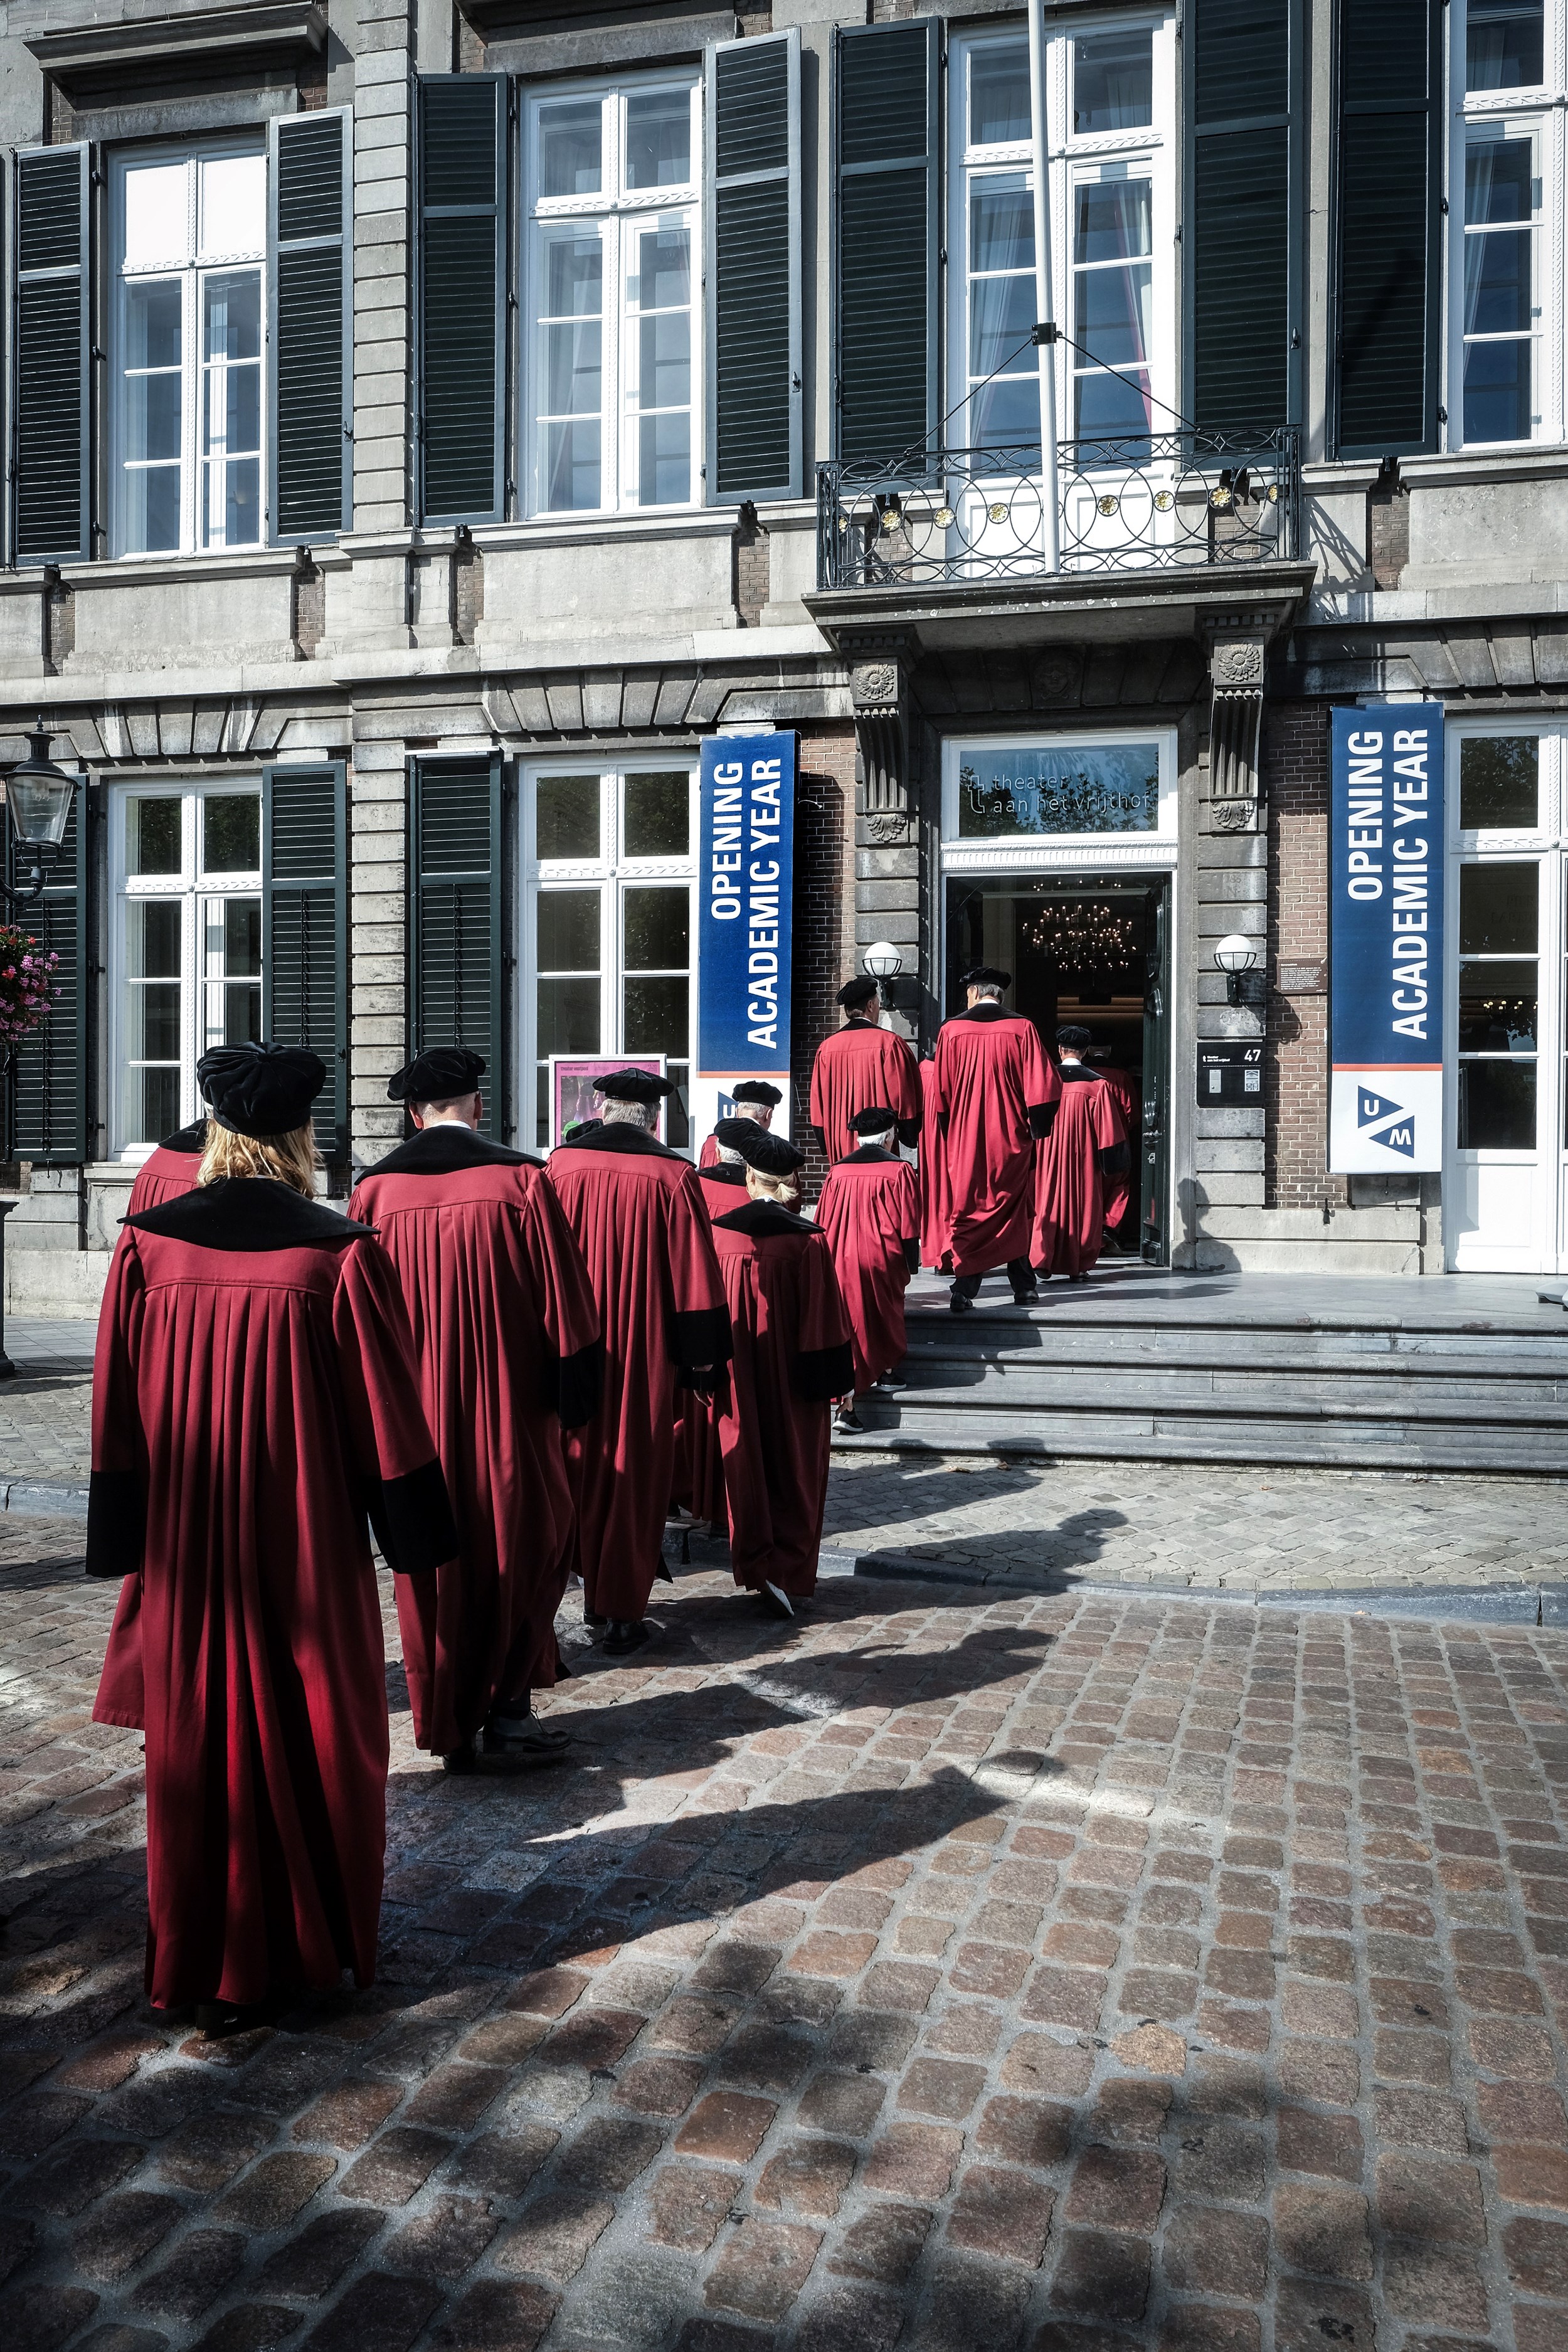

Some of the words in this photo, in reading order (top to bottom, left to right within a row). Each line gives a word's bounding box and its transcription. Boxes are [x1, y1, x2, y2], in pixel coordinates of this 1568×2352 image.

[750, 758, 781, 852] YEAR
[993, 774, 1068, 790] theater
[993, 800, 1027, 813] aan
[1037, 795, 1067, 811] het
[1075, 791, 1149, 813] vrijthof
[1393, 729, 1429, 828] YEAR
[711, 761, 743, 920] OPENING
[1347, 731, 1384, 901] OPENING
[747, 861, 780, 1049] ACADEMIC
[1392, 838, 1429, 1040] ACADEMIC
[1244, 1049, 1261, 1062] 47
[723, 1104, 736, 1119] U
[1364, 1099, 1379, 1116] U
[1389, 1129, 1412, 1145] M
